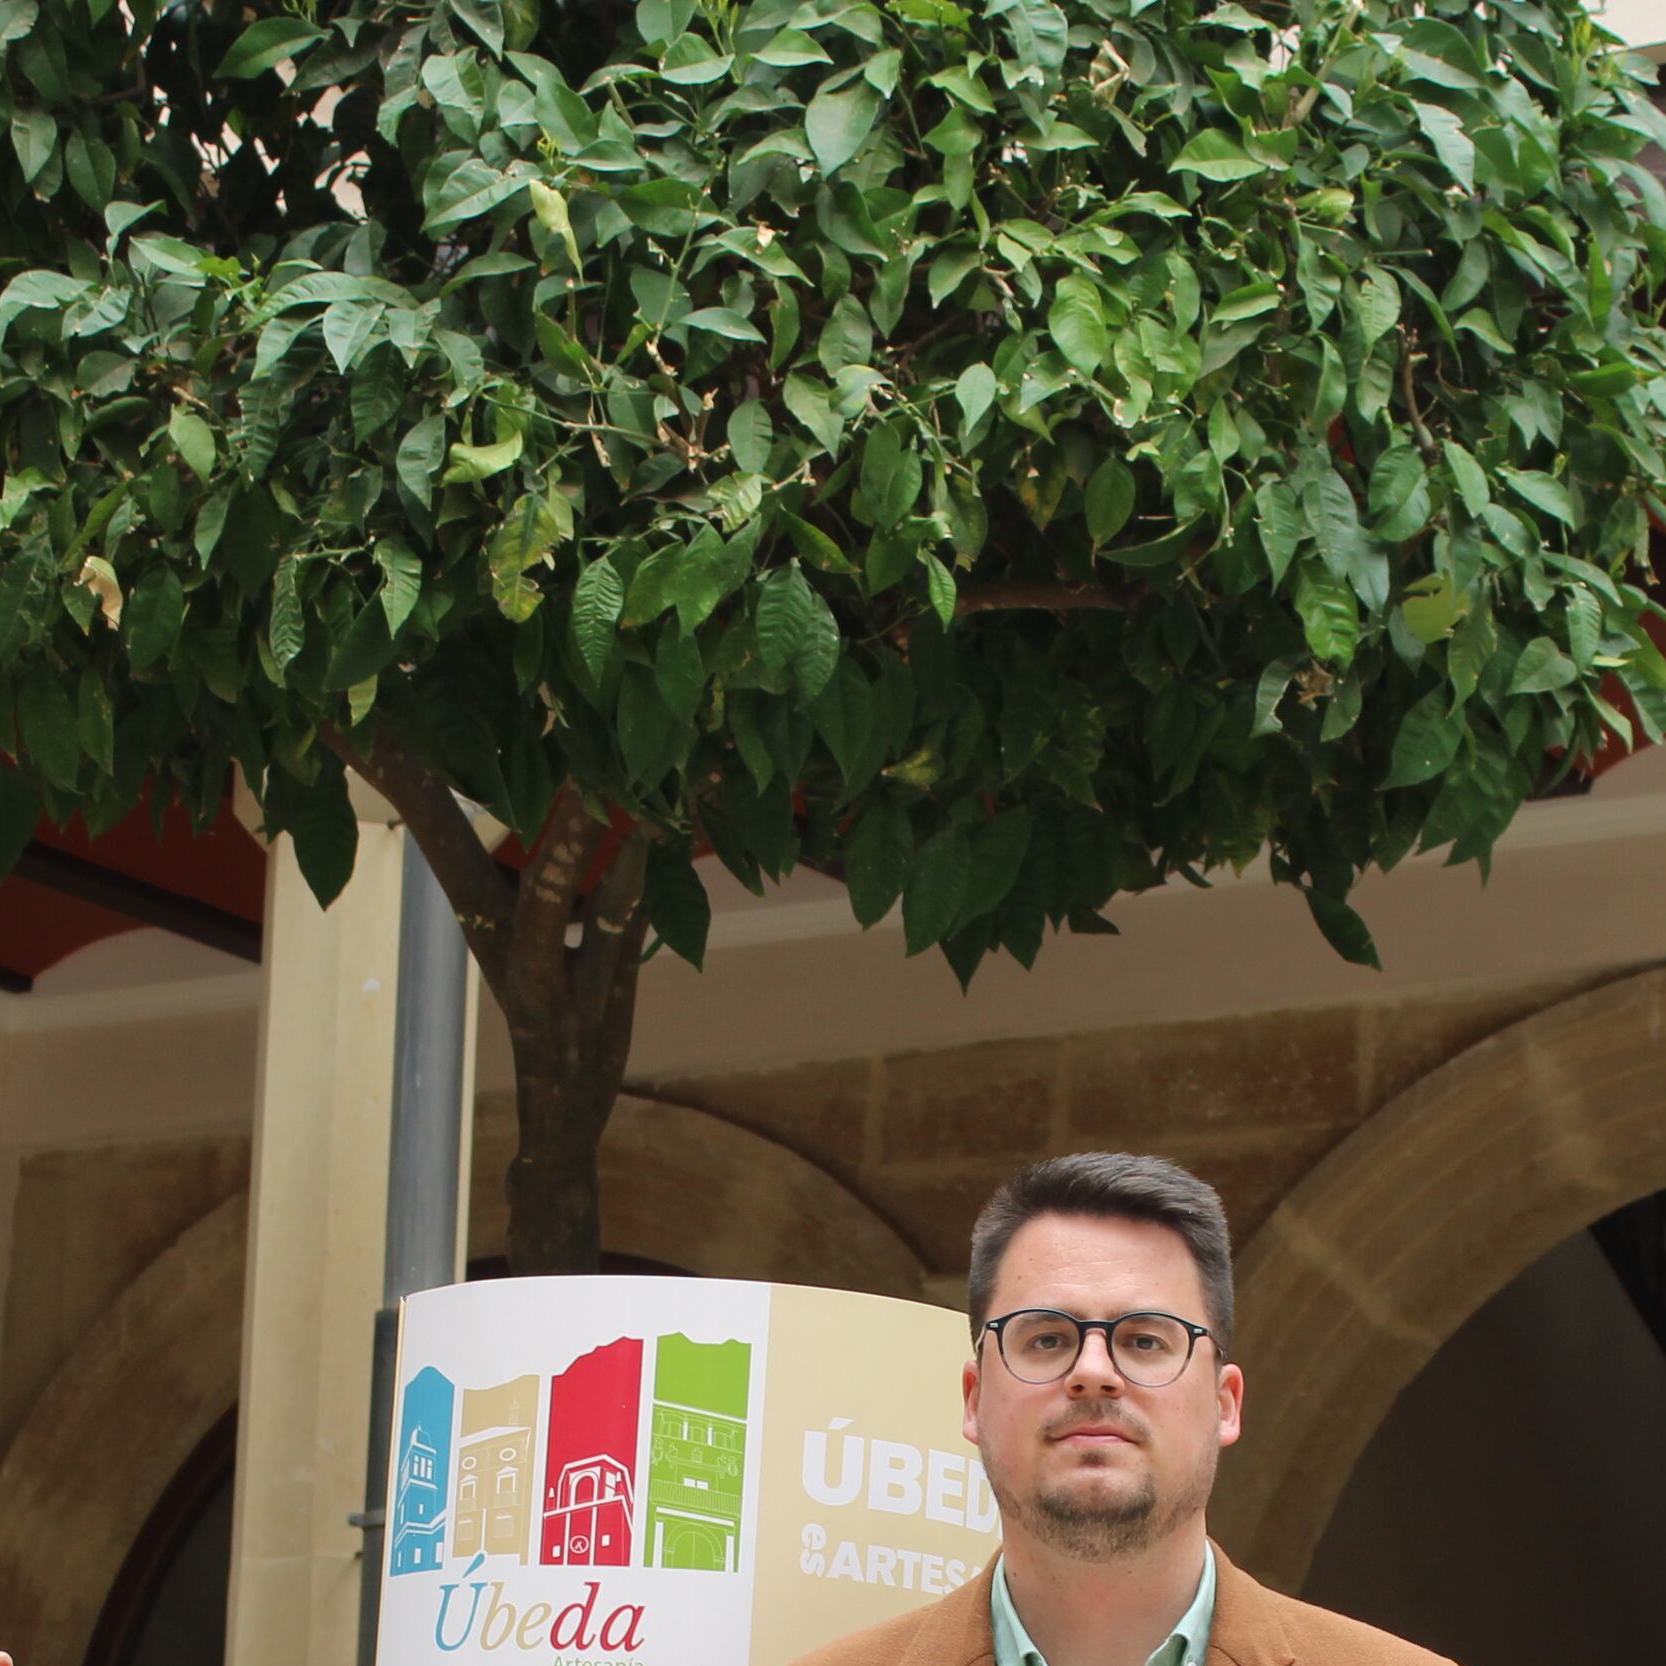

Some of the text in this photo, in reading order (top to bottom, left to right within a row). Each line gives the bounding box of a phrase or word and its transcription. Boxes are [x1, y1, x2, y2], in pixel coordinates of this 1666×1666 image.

[802, 1417, 1003, 1541] ÚBED
[435, 1550, 646, 1654] Úbeda
[826, 1540, 982, 1595] ARTES
